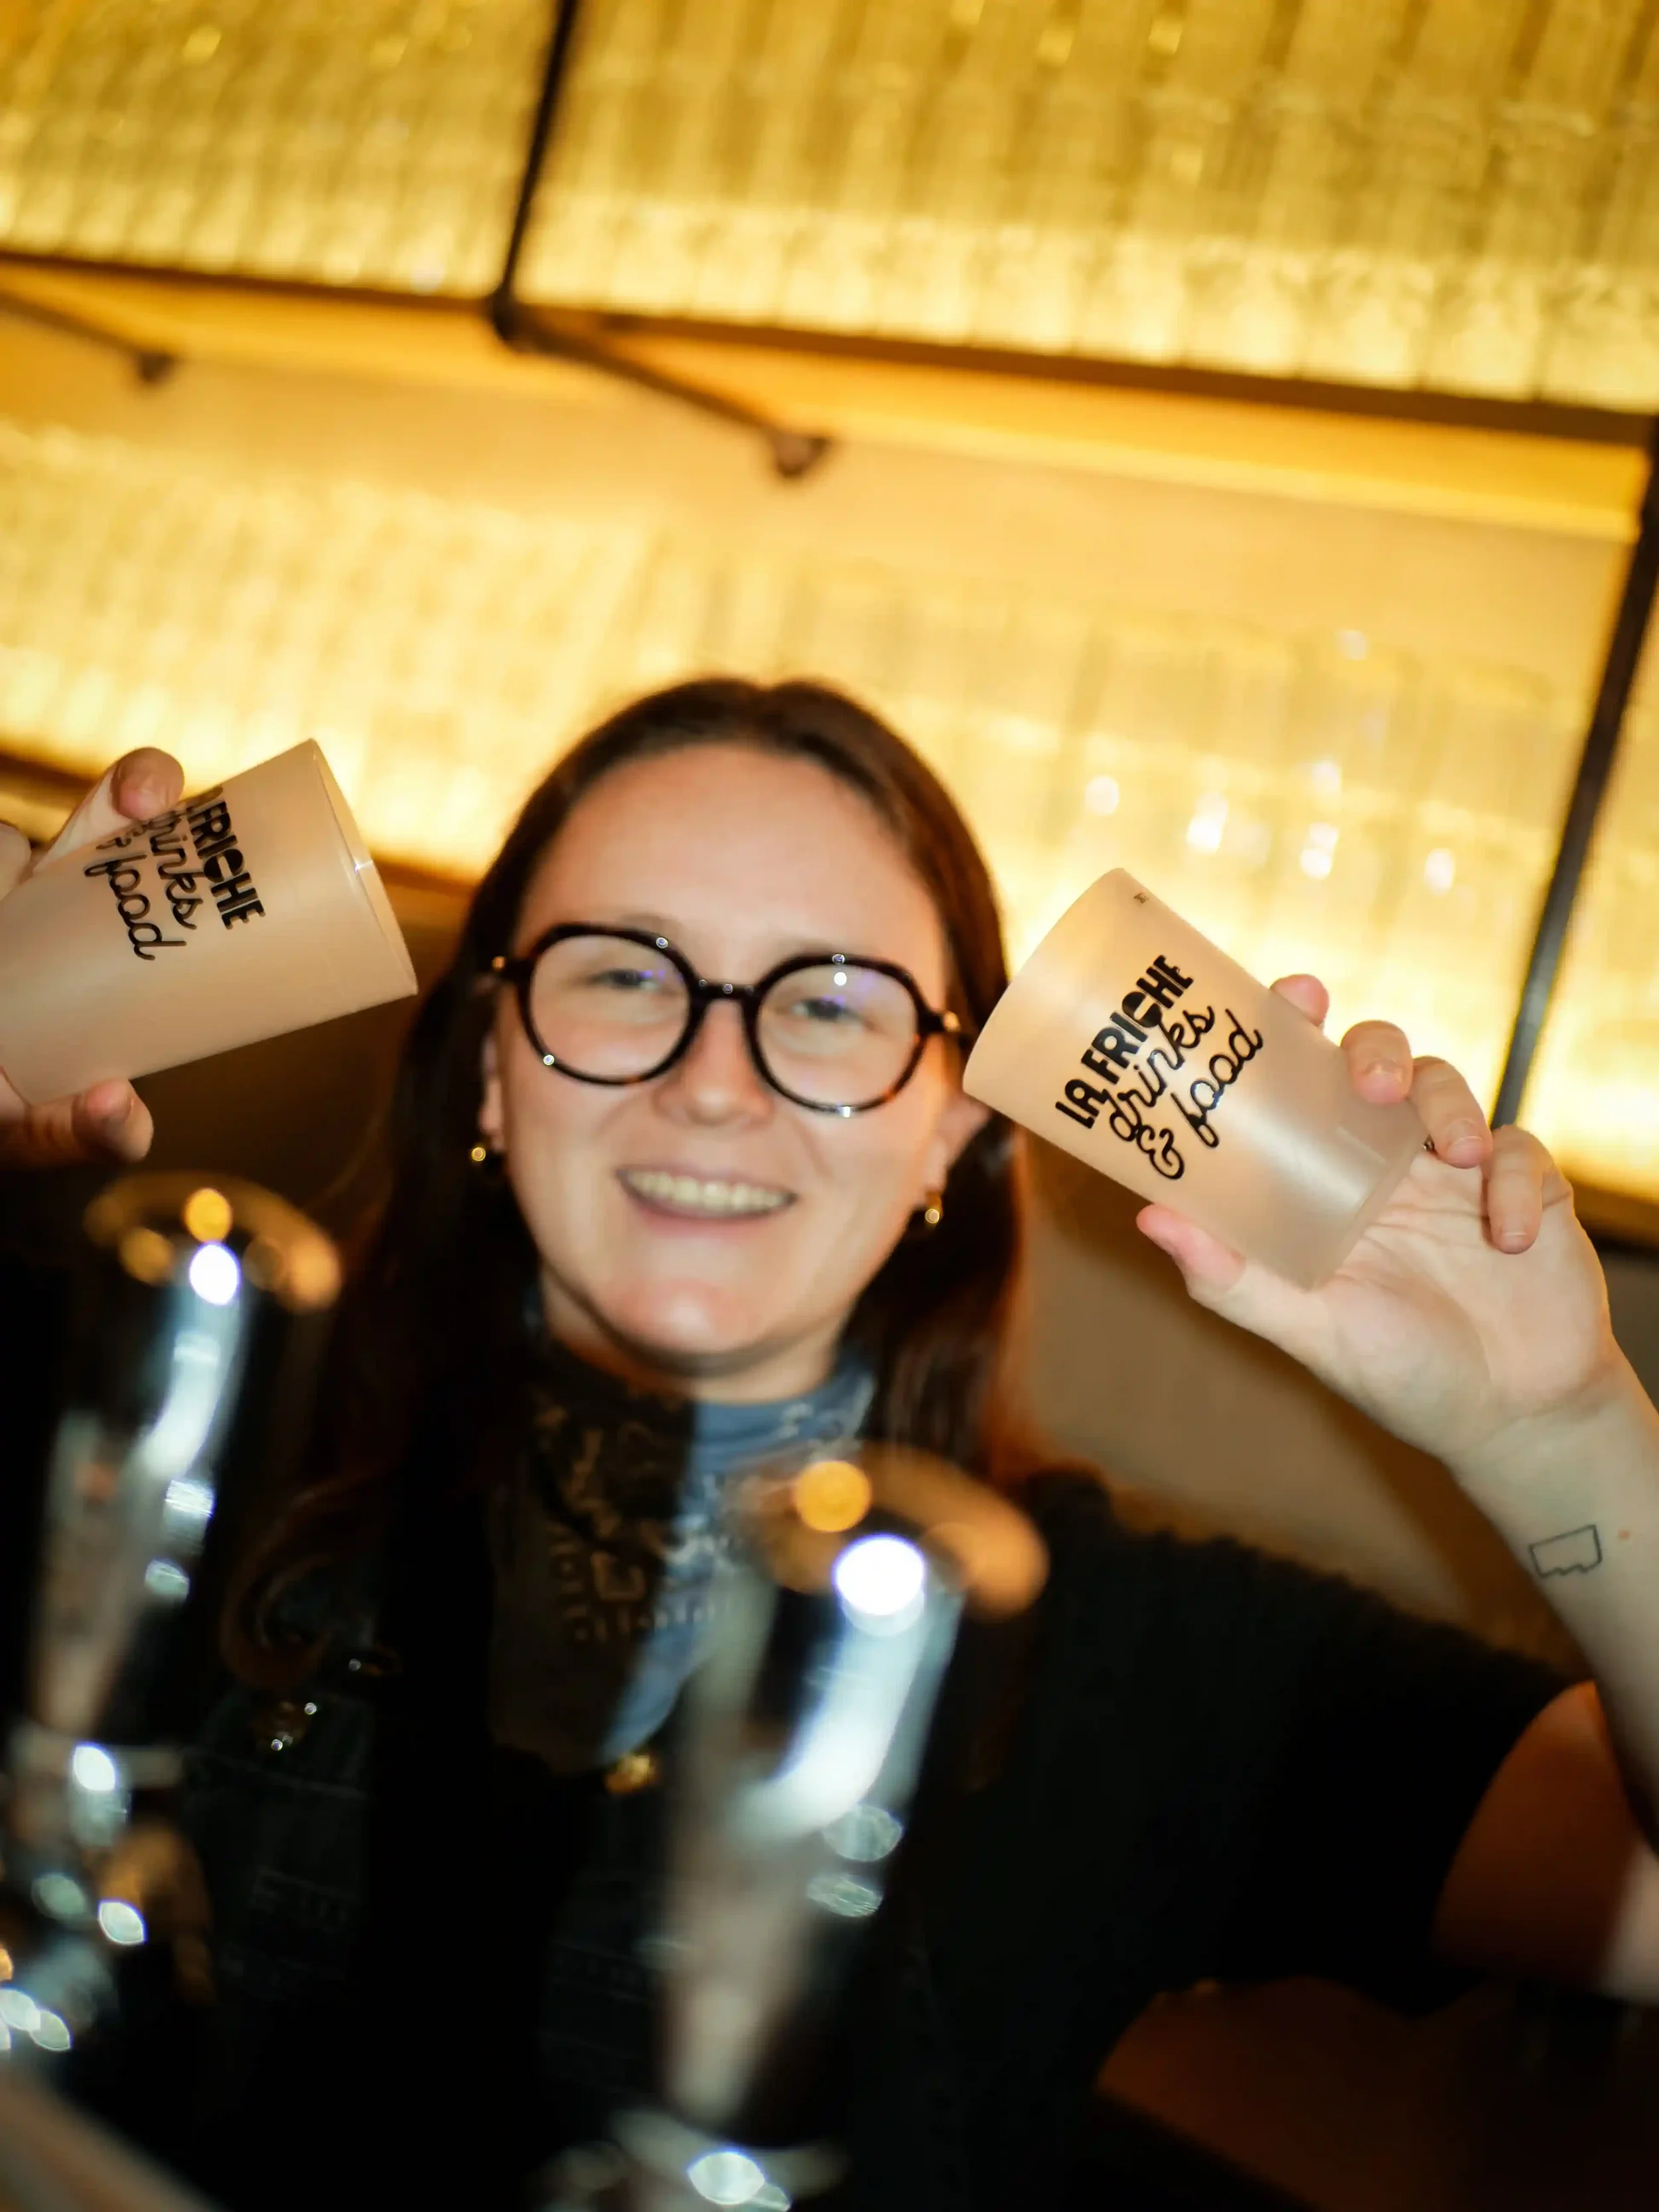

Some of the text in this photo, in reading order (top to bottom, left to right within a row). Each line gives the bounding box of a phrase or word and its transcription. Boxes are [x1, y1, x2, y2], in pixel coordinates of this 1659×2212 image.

[84, 852, 187, 960] food
[187, 798, 265, 930] FRICHE
[1055, 954, 1194, 1129] LA FRICHE
[1109, 1005, 1215, 1142] drinks
[1135, 1008, 1263, 1180] & food
